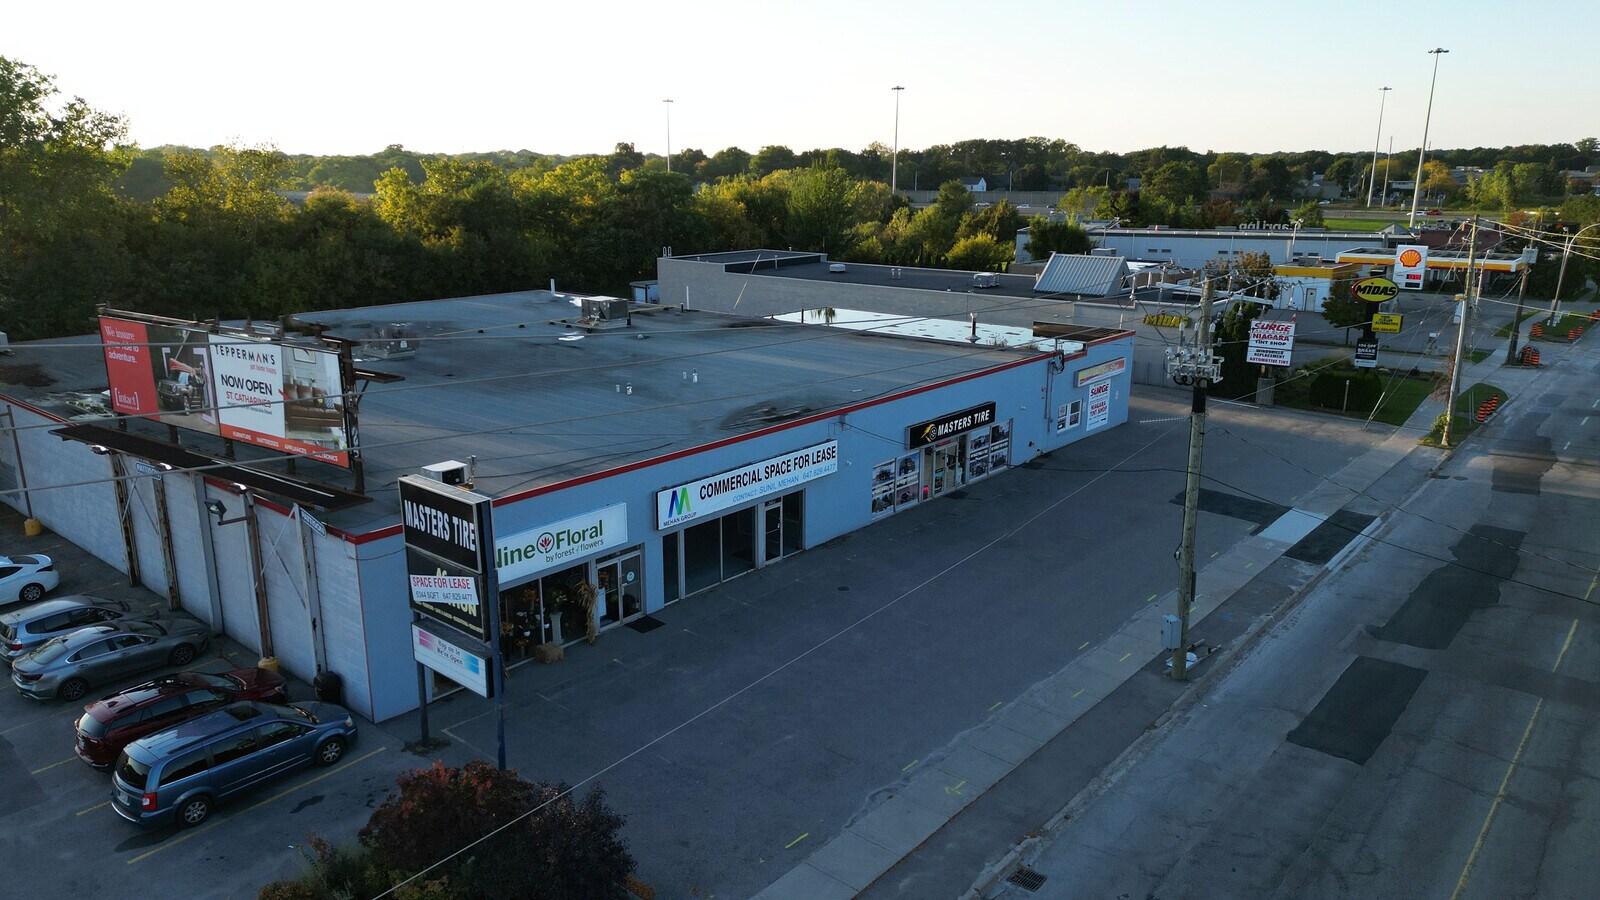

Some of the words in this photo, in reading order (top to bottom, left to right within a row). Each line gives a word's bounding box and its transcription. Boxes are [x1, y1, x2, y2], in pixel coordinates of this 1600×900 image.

[1356, 282, 1396, 296] MIDAS
[1143, 314, 1189, 328] MIDAS
[1254, 322, 1292, 332] SURGE
[104, 326, 115, 336] We
[116, 329, 135, 340] insure
[1252, 333, 1289, 341] NIAGARA
[108, 351, 137, 363] adventure.
[215, 344, 275, 365] TEPPERMAN'S
[221, 374, 244, 389] NOW
[245, 379, 273, 396] OPEN
[1090, 383, 1109, 396] SURGE
[226, 391, 234, 400] ST.
[1098, 406, 1107, 414] SHOP
[937, 415, 972, 436] MASTERS
[973, 409, 990, 424] TIRE
[284, 444, 307, 454] APPLIANCES
[699, 469, 763, 500] COMMERCIAL
[764, 458, 791, 480] SPACE
[793, 453, 810, 471] FOR
[812, 446, 836, 465] LEASE
[759, 483, 776, 494] SUNIL
[778, 476, 799, 488] MEHAN
[404, 499, 451, 541] MASTERS
[452, 515, 476, 552] TIRE
[663, 518, 680, 526] MEHAN
[680, 511, 697, 521] GROUP
[556, 519, 603, 550] Floral
[545, 555, 554, 563] by
[555, 547, 575, 559] forest
[580, 538, 604, 550] flowers
[412, 576, 432, 588] SPACE
[433, 577, 448, 588] FOR
[448, 578, 471, 589] LEASE
[449, 654, 463, 665] Open
